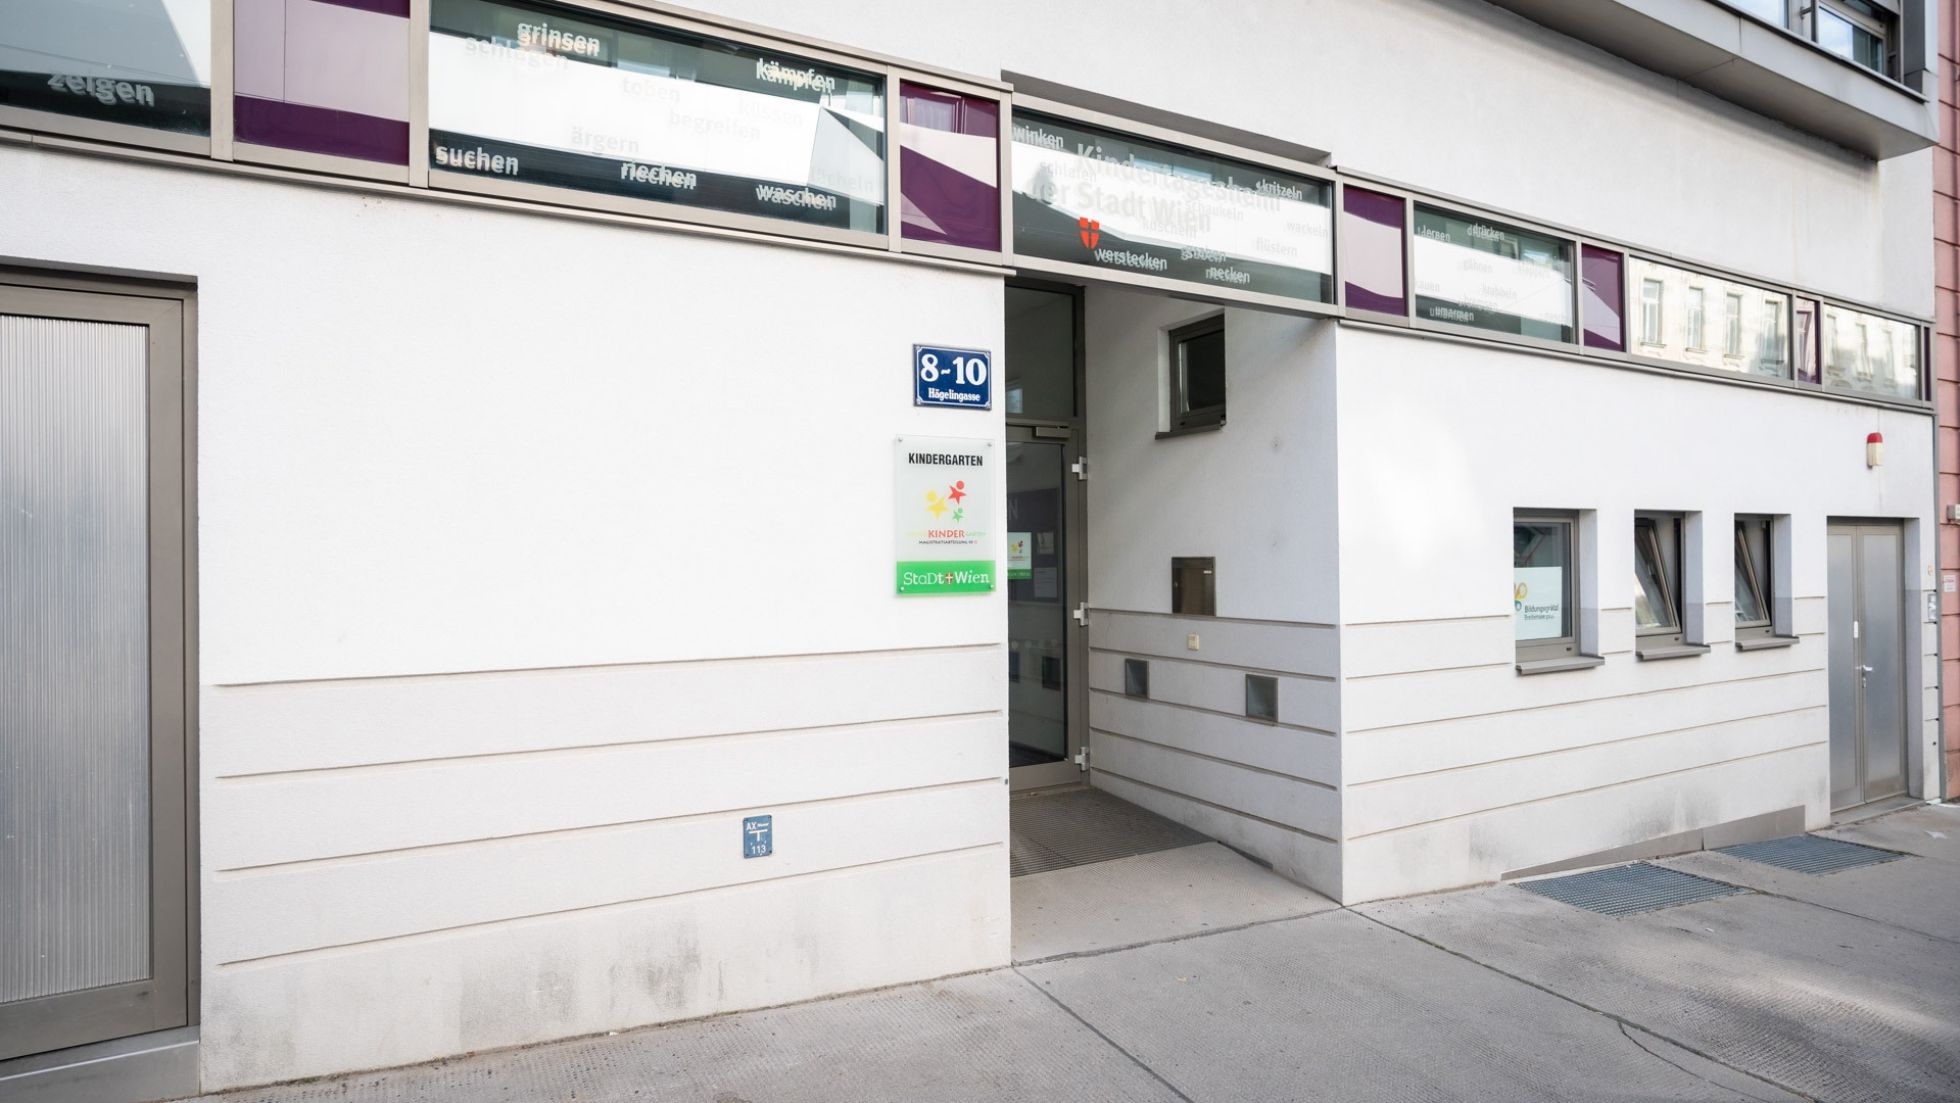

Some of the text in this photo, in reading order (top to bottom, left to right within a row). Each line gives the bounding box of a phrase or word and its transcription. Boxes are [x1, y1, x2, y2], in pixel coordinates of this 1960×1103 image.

[517, 22, 600, 57] grinsen
[621, 76, 681, 103] toben
[755, 58, 836, 93] kämpfen
[48, 73, 155, 108] zeigen
[571, 127, 640, 155] ärgern
[1012, 126, 1065, 150] winken
[435, 145, 519, 176] suchen
[621, 161, 698, 190] riechen
[755, 183, 837, 211] waschen
[1078, 181, 1146, 219] Stadt
[1154, 197, 1212, 232] Wien
[1094, 247, 1168, 271] verstecken
[920, 353, 988, 386] 8-10
[928, 388, 981, 403] Hägelingasse
[908, 452, 983, 467] KINDERGARTEN
[954, 570, 990, 585] Wien
[751, 845, 766, 855] 113
